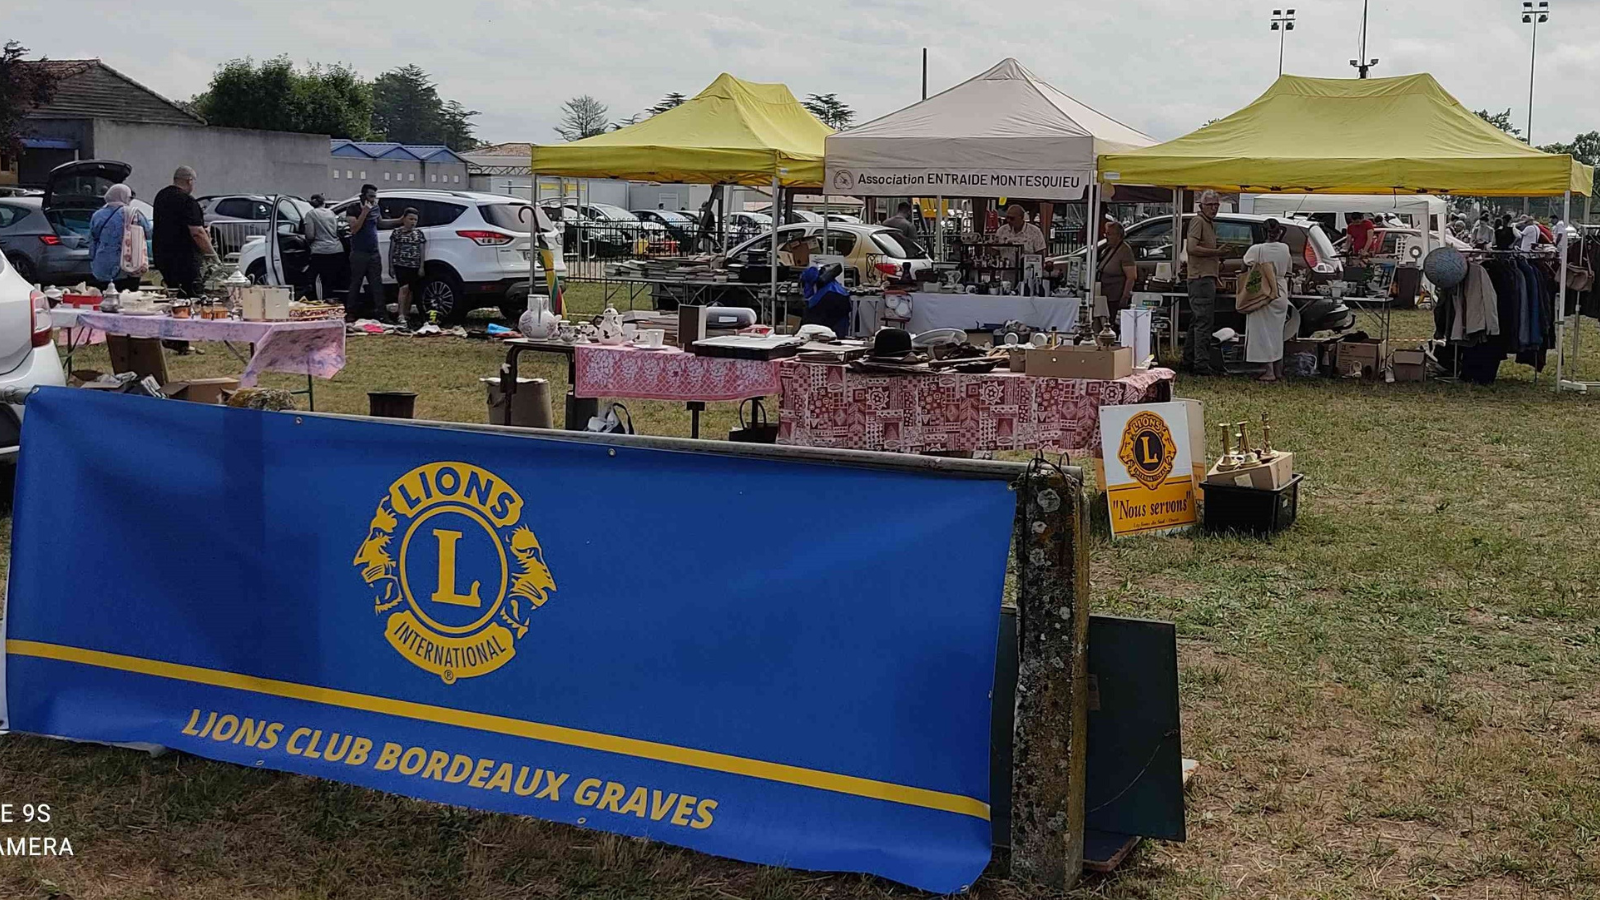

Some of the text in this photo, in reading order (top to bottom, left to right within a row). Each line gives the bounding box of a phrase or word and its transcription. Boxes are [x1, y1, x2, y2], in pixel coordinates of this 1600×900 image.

[857, 172, 1080, 189] Association ENTRAIDE MONTESQUIEU
[1132, 418, 1163, 433] LIONS
[1140, 436, 1159, 464] L
[398, 466, 516, 521] LIONS
[1112, 491, 1191, 520] "Nous servons"
[430, 528, 482, 608] L
[393, 620, 507, 669] INTERNATIONAL
[181, 708, 719, 830] LIONS CLUB BORDEAUX GRAVES
